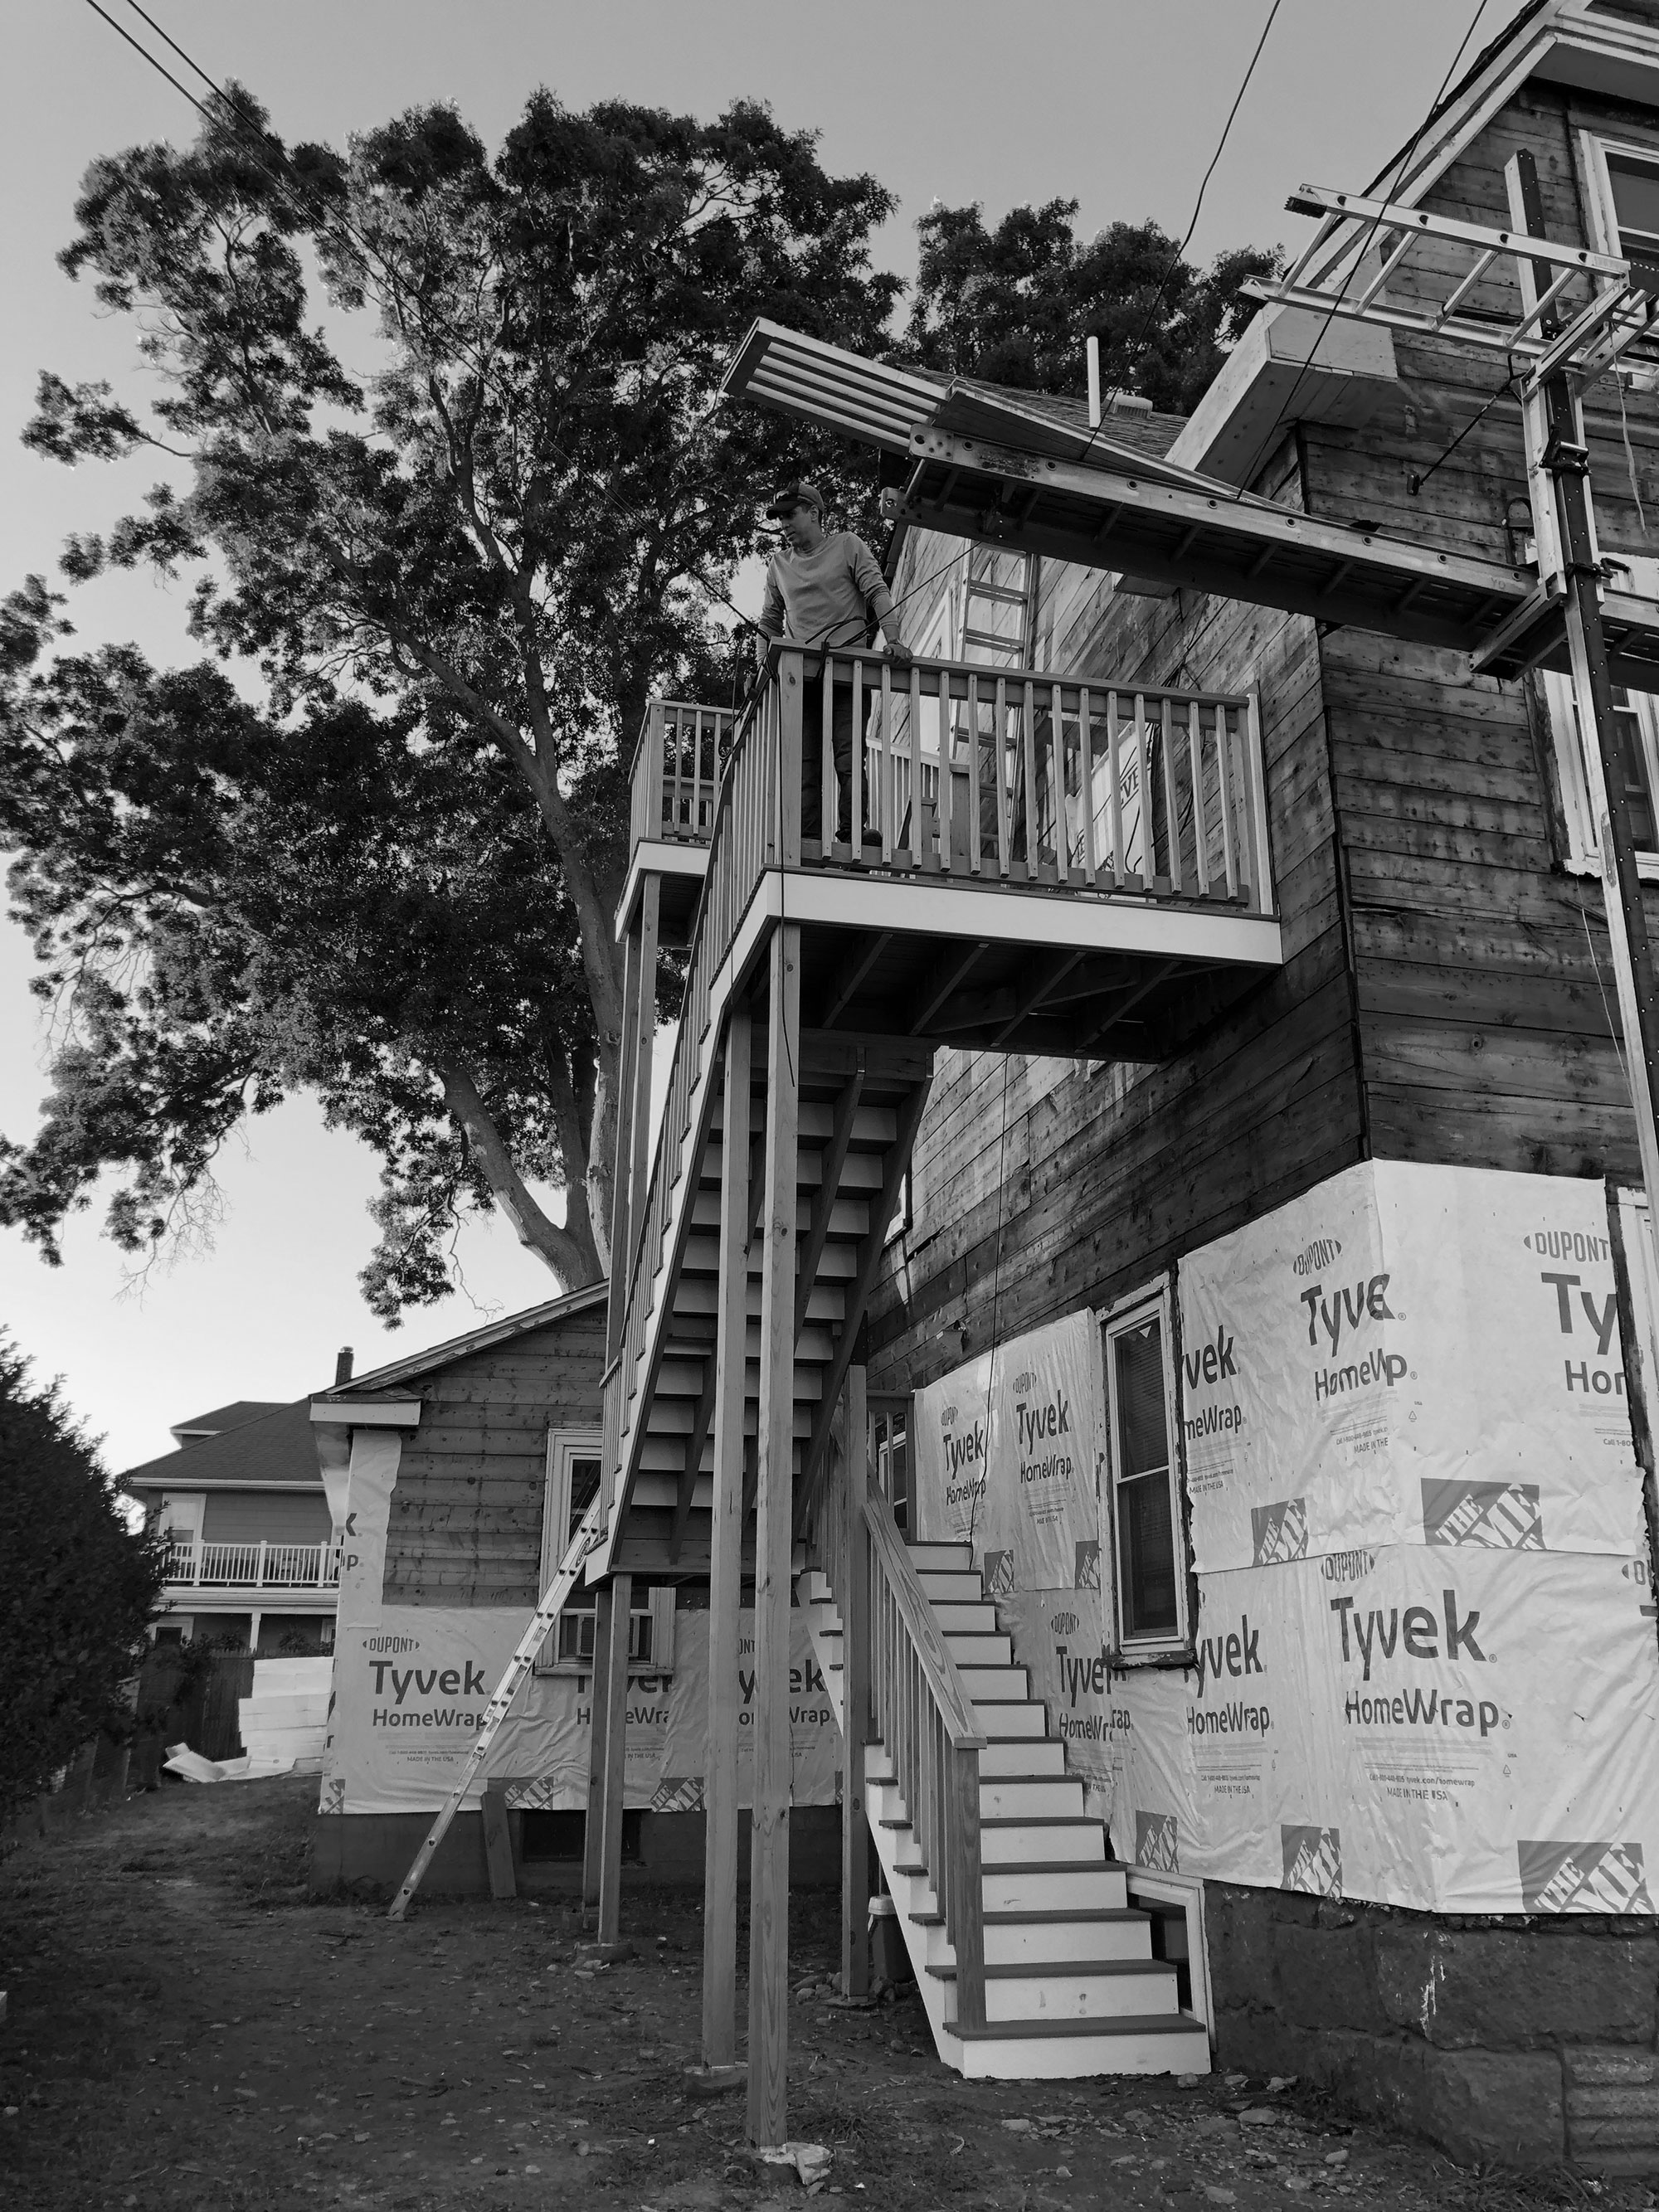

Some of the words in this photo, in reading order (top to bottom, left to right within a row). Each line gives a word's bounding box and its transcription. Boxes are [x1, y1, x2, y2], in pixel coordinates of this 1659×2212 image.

[1535, 1231, 1608, 1262] DUPONT
[1016, 1389, 1069, 1456] Tyvek
[943, 1420, 985, 1480] Tyvek
[1354, 1441, 1370, 1454] MADE
[1376, 1437, 1389, 1448] THE
[1603, 1437, 1615, 1446] Call
[1020, 1454, 1072, 1484] HomeWrap
[369, 1636, 415, 1654] DUPONT
[1330, 1589, 1487, 1681] Tyvek
[368, 1660, 486, 1705] Tyvek
[1186, 1701, 1270, 1738] HomeWrap
[1345, 1688, 1500, 1738] HomeWrap
[1387, 1787, 1403, 1798] MADE
[1403, 1788, 1411, 1799] IN
[1411, 1789, 1429, 1800] THE
[1432, 1790, 1448, 1801] USA
[1534, 1856, 1585, 1913] THE
